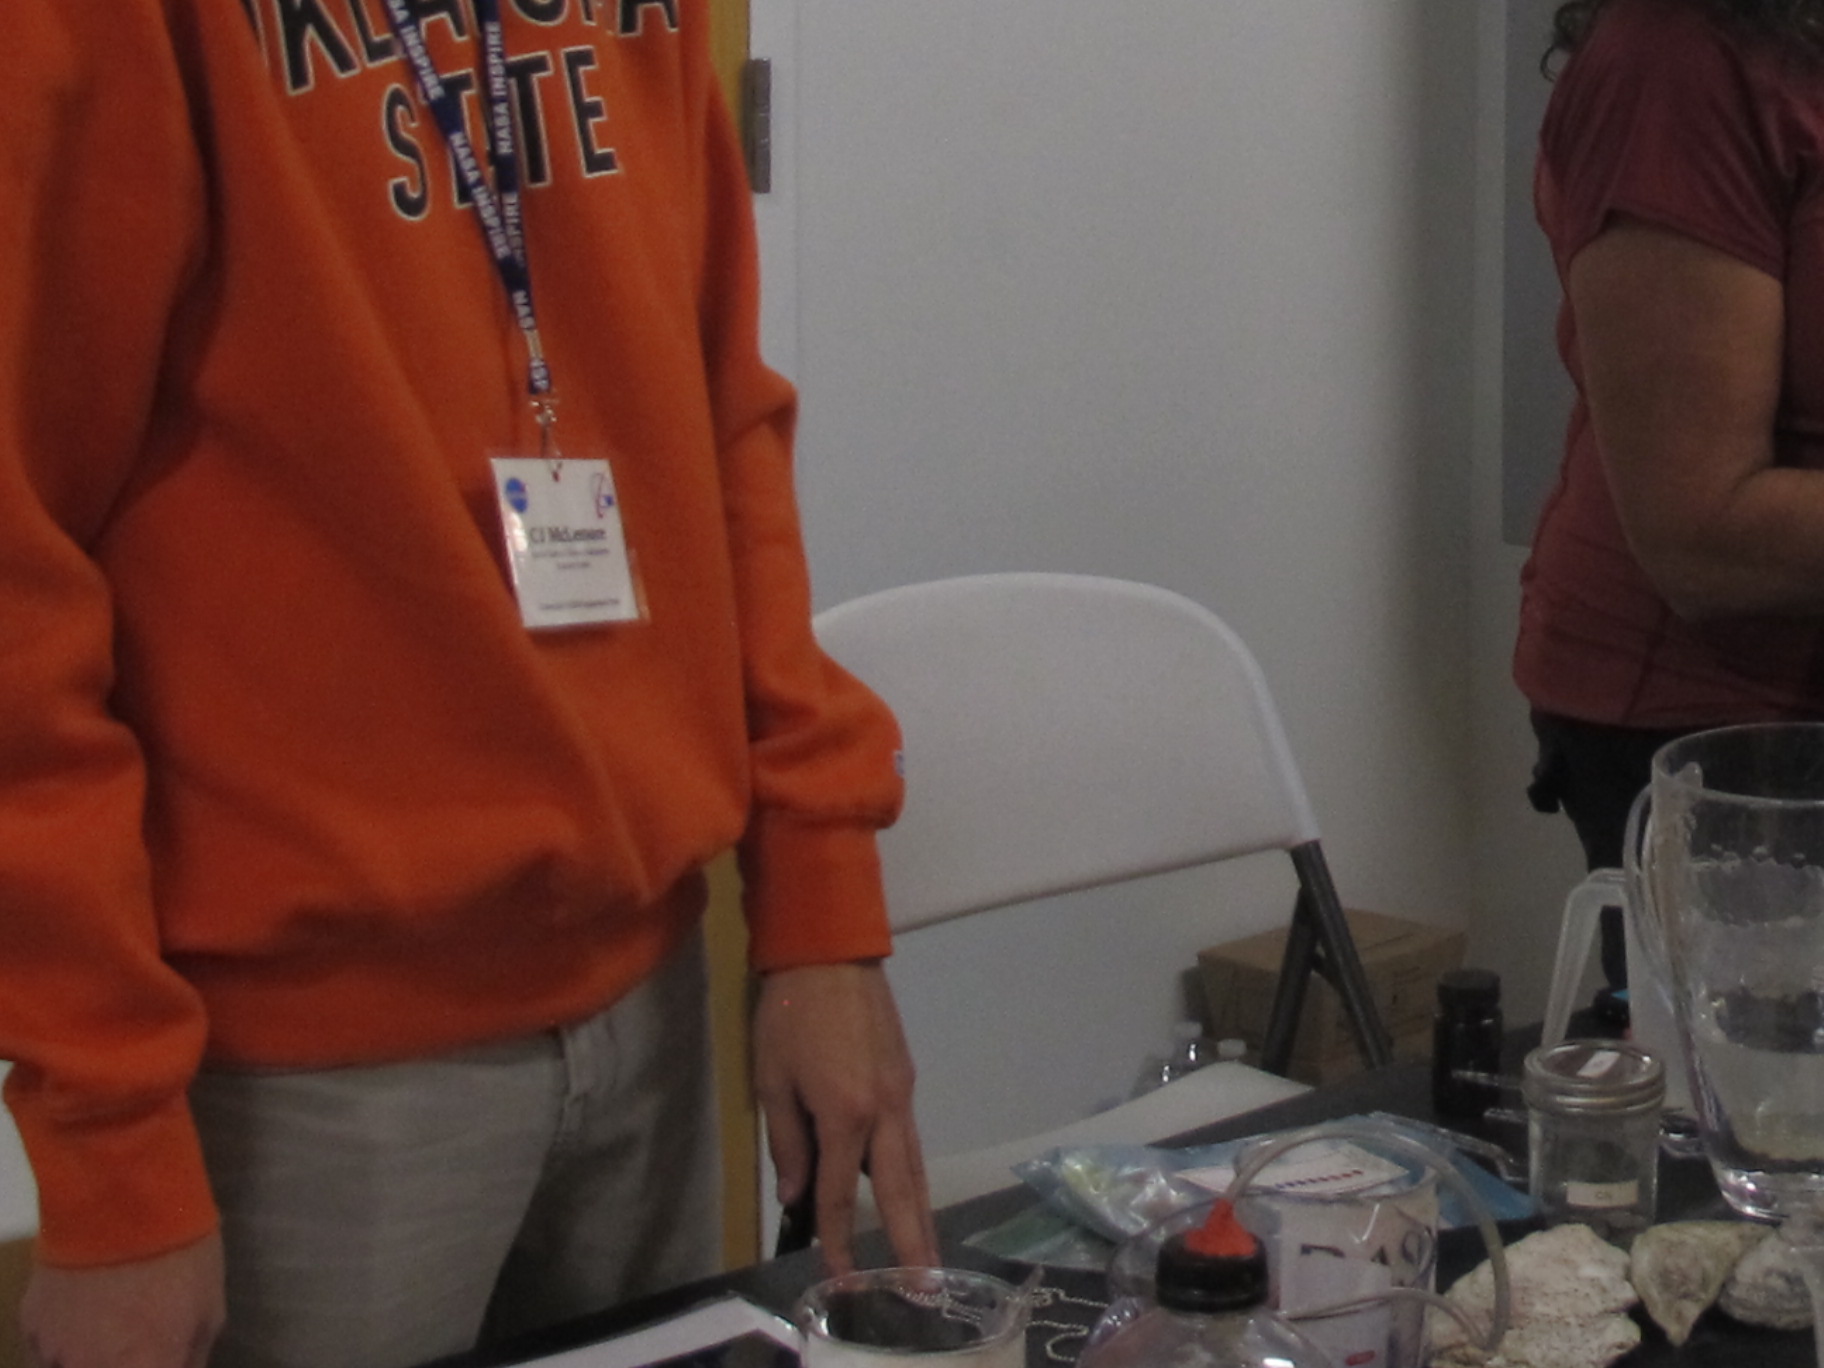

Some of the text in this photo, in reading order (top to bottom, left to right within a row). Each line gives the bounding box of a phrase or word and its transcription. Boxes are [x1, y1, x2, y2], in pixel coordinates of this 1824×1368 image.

[399, 25, 446, 100] INSPIRE
[484, 21, 514, 155] NASA INSPIRE
[383, 45, 622, 220] STTE
[449, 131, 513, 260] NASA INSPIRE
